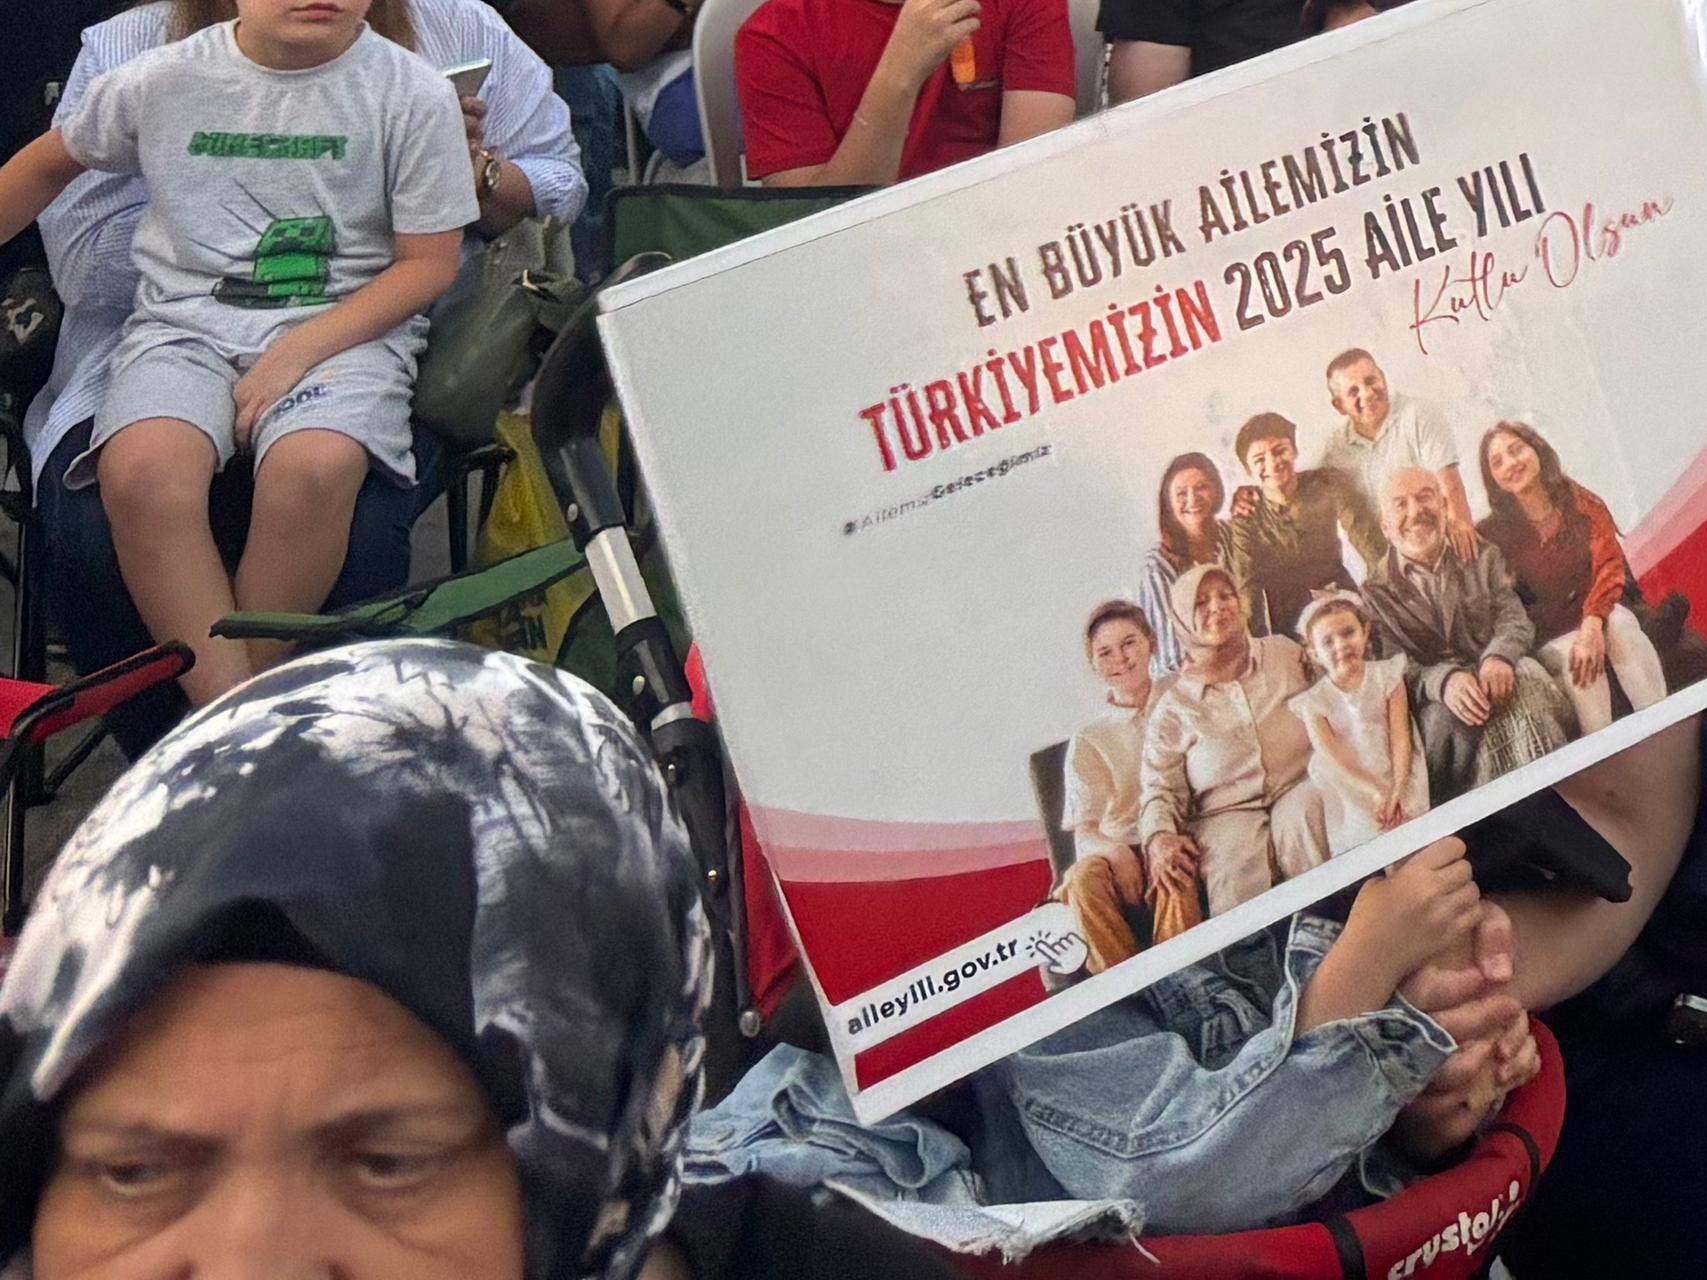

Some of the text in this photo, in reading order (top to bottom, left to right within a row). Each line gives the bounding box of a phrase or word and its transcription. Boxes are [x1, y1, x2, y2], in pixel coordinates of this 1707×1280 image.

[858, 151, 1548, 473] TÜRKİYEMİZİN 2025 AİLE YILI
[962, 111, 1421, 328] EN BÜYÜK AİLEMİZİN
[1409, 192, 1675, 356] Kutlu Olsun
